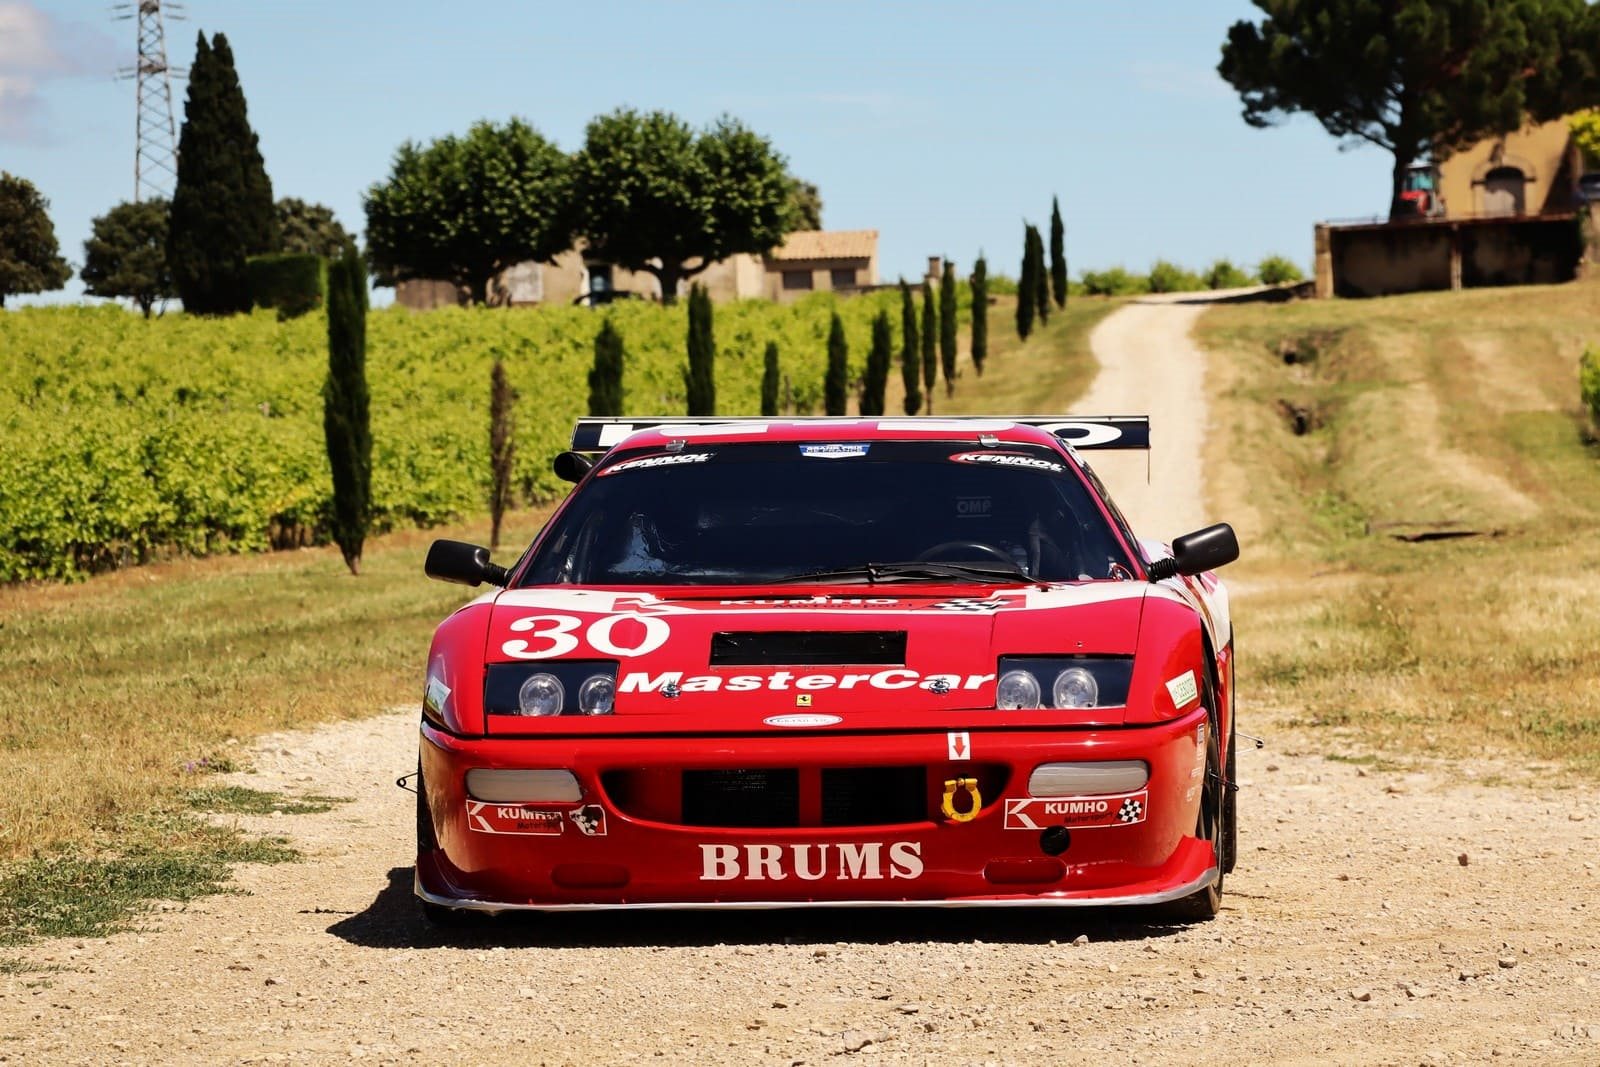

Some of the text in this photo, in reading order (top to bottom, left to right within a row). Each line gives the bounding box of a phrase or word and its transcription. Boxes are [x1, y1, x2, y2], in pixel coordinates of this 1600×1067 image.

[604, 452, 709, 474] KENNOL
[958, 454, 1063, 473] KENNOL
[957, 501, 991, 513] OMP
[501, 614, 671, 660] 30
[617, 669, 996, 693] MasterCar
[1045, 801, 1108, 815] KUMHO
[698, 841, 924, 881] BRUMS
